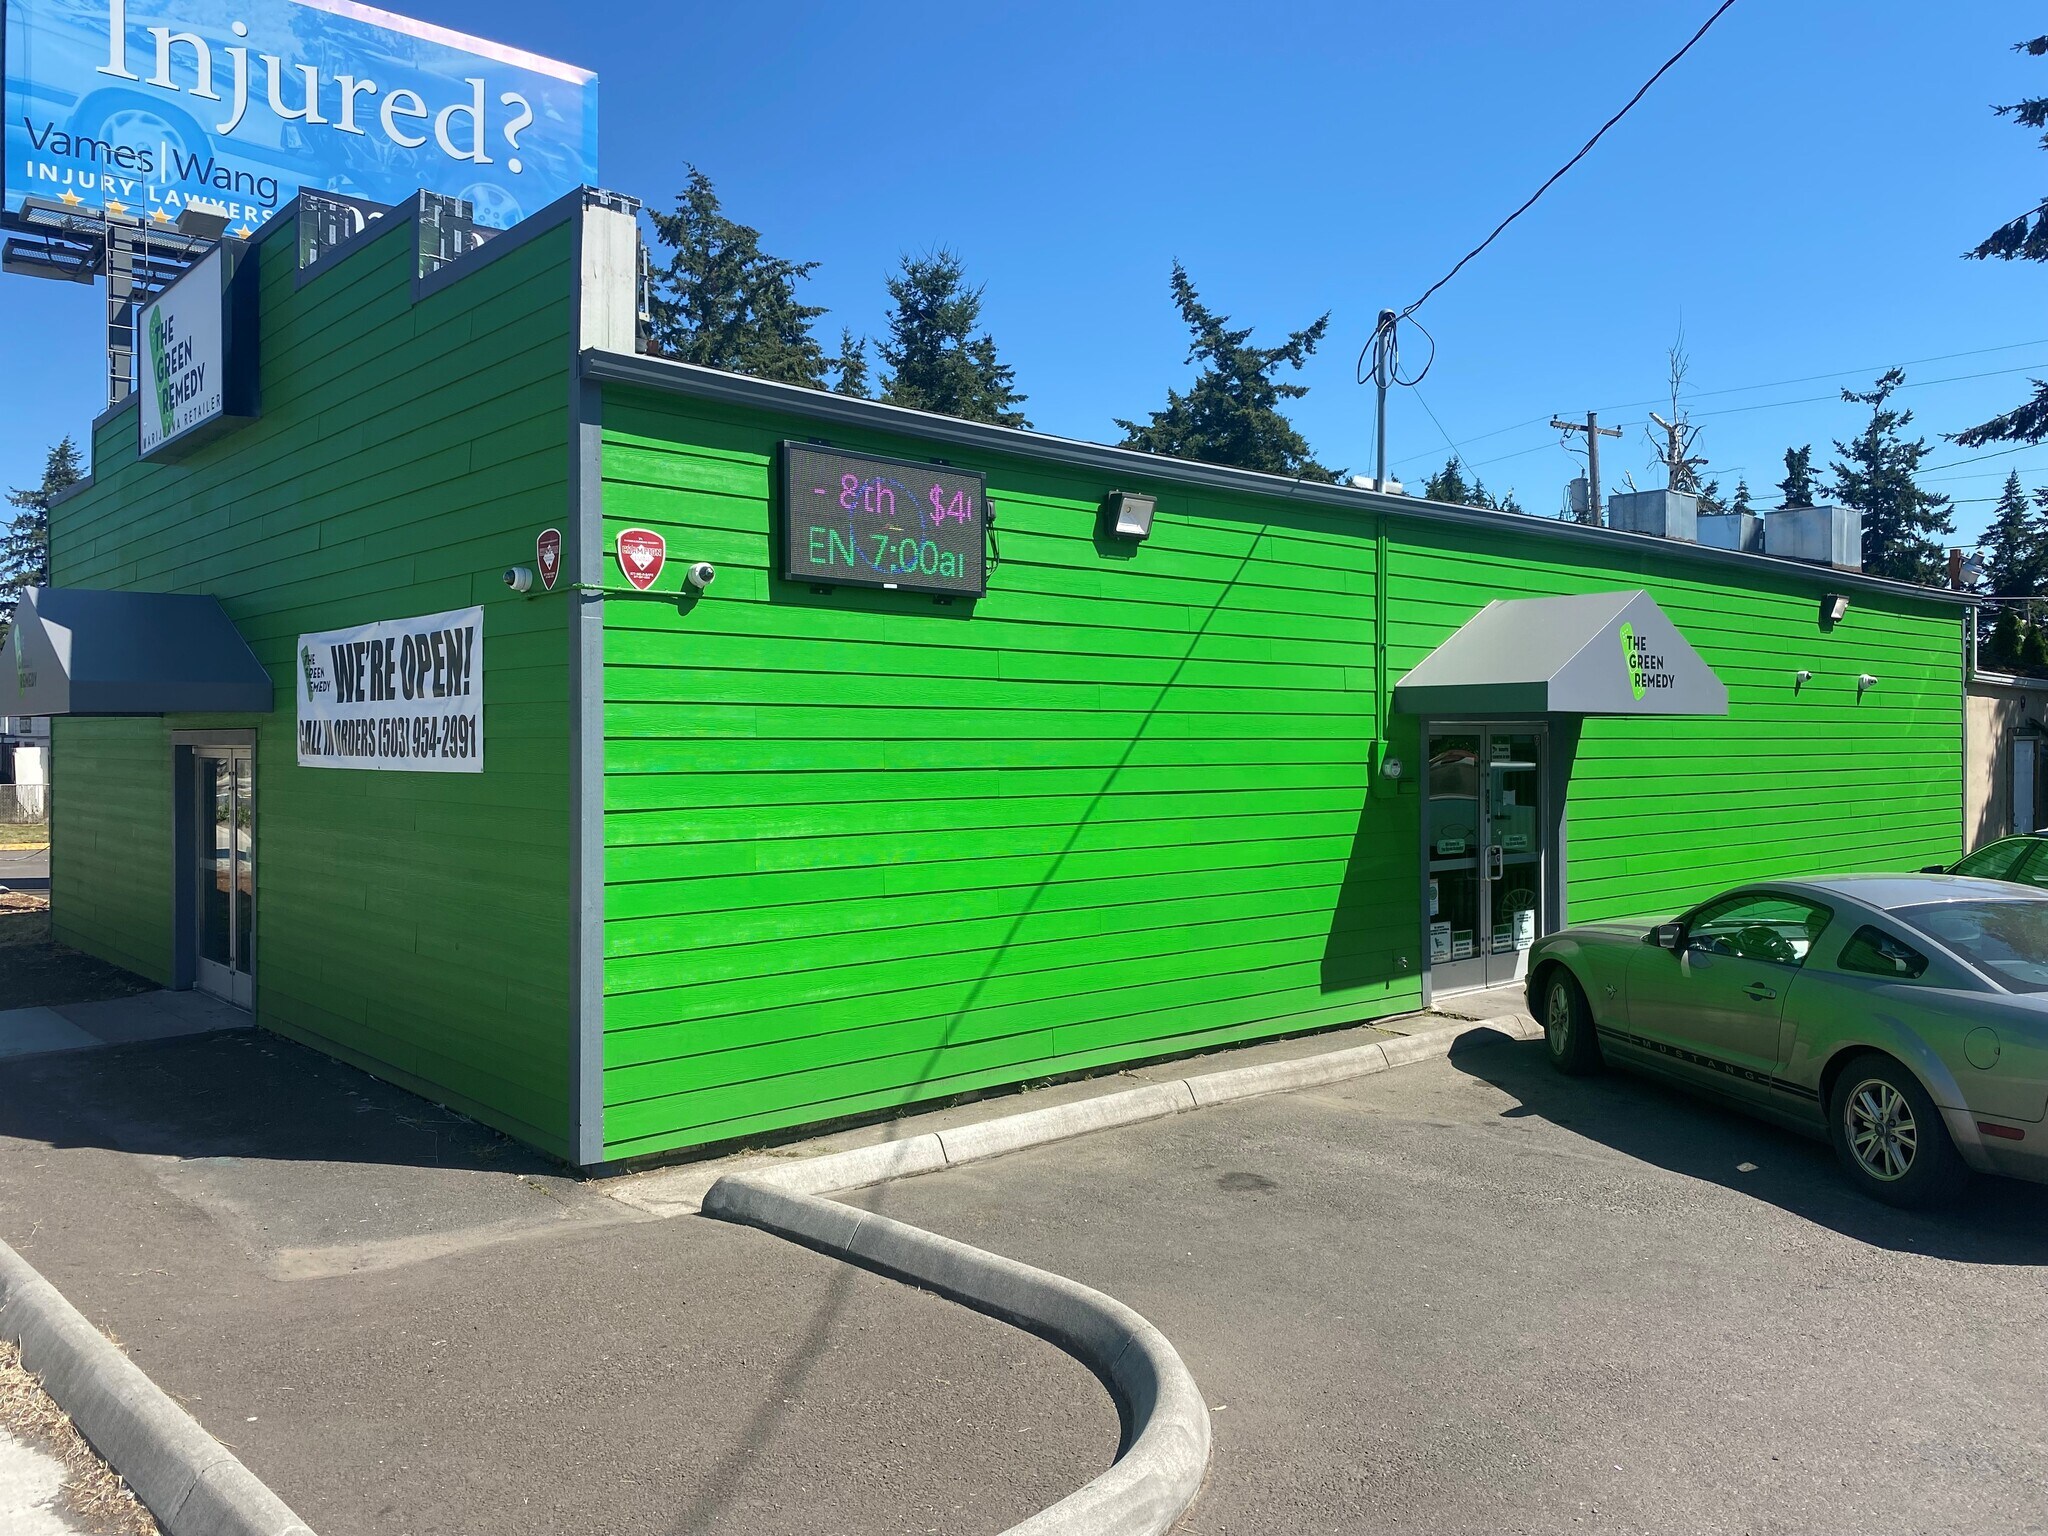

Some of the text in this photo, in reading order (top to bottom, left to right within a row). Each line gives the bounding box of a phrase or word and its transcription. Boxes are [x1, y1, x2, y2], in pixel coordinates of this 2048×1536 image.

[96, 0, 533, 174] Injured?
[24, 117, 278, 207] Vames Wang
[26, 160, 274, 224] INJURY LAWYERS
[154, 315, 174, 351] THE
[157, 336, 192, 383] GREEN
[162, 362, 206, 414] REMEDY
[184, 394, 221, 425] RETAILER
[839, 473, 896, 516] 8th
[810, 525, 855, 567] EN
[305, 653, 316, 666] THE
[1626, 636, 1646, 651] THE
[1629, 655, 1664, 669] GREEN
[331, 627, 474, 703] WE'RE OPEN!
[1634, 673, 1675, 688] REMEDY
[308, 680, 331, 693] EMEDY
[300, 714, 476, 759] CALL IN ORDERS (503) 954-2991
[1642, 1040, 1754, 1081] MUSTANG
